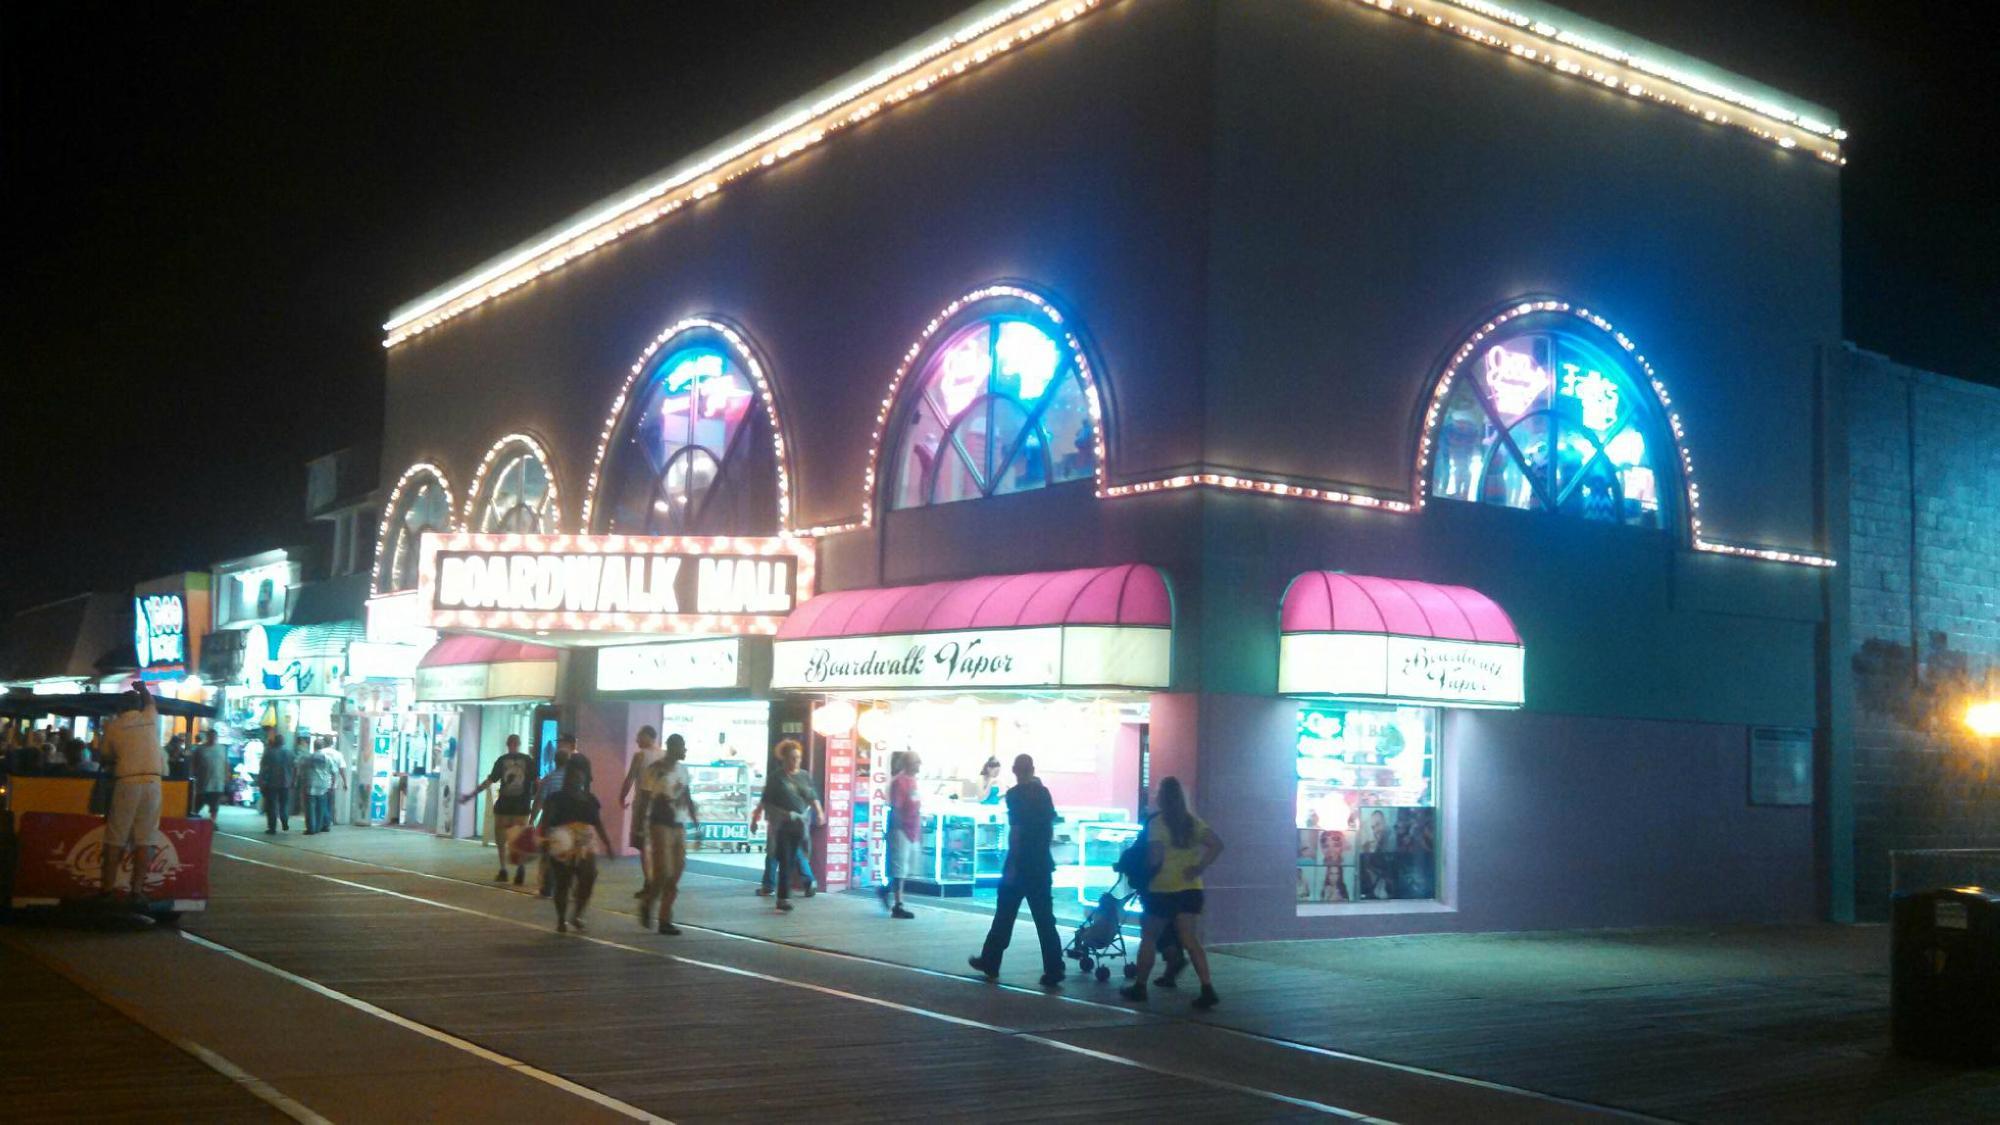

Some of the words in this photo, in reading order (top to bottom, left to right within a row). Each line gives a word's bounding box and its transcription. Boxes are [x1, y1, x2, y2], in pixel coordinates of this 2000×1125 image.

[440, 555, 682, 612] BOARDWALK
[697, 557, 790, 612] MALL
[805, 646, 925, 682] Boardwalk
[934, 639, 1014, 681] Vapor
[1402, 648, 1503, 676] Boadwalk
[705, 824, 747, 838] FUDGE
